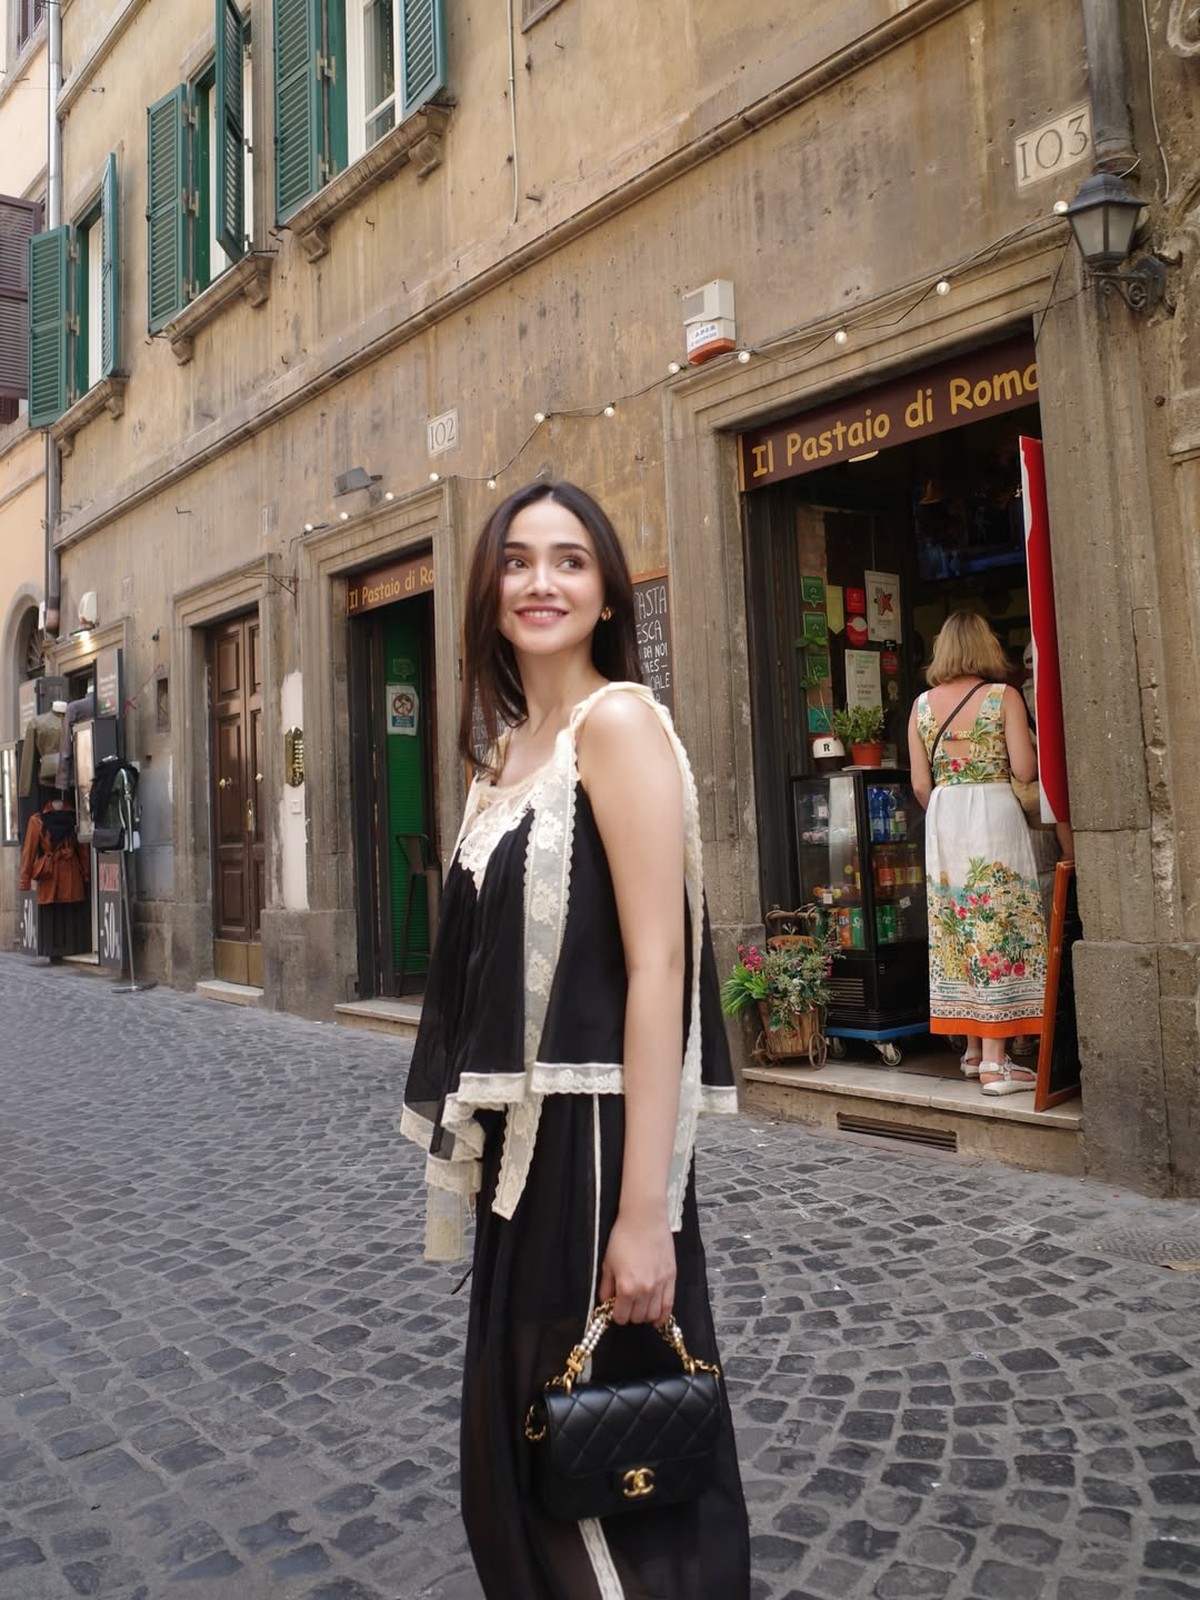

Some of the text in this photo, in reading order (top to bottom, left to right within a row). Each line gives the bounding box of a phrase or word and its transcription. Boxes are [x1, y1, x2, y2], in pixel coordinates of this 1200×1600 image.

[1019, 113, 1088, 180] 103
[430, 417, 455, 450] 102
[751, 440, 774, 478] Il
[786, 409, 890, 467] Pastaio
[904, 388, 933, 428] di
[349, 589, 358, 610] Il
[362, 577, 400, 605] Pastaio
[404, 568, 416, 591] di
